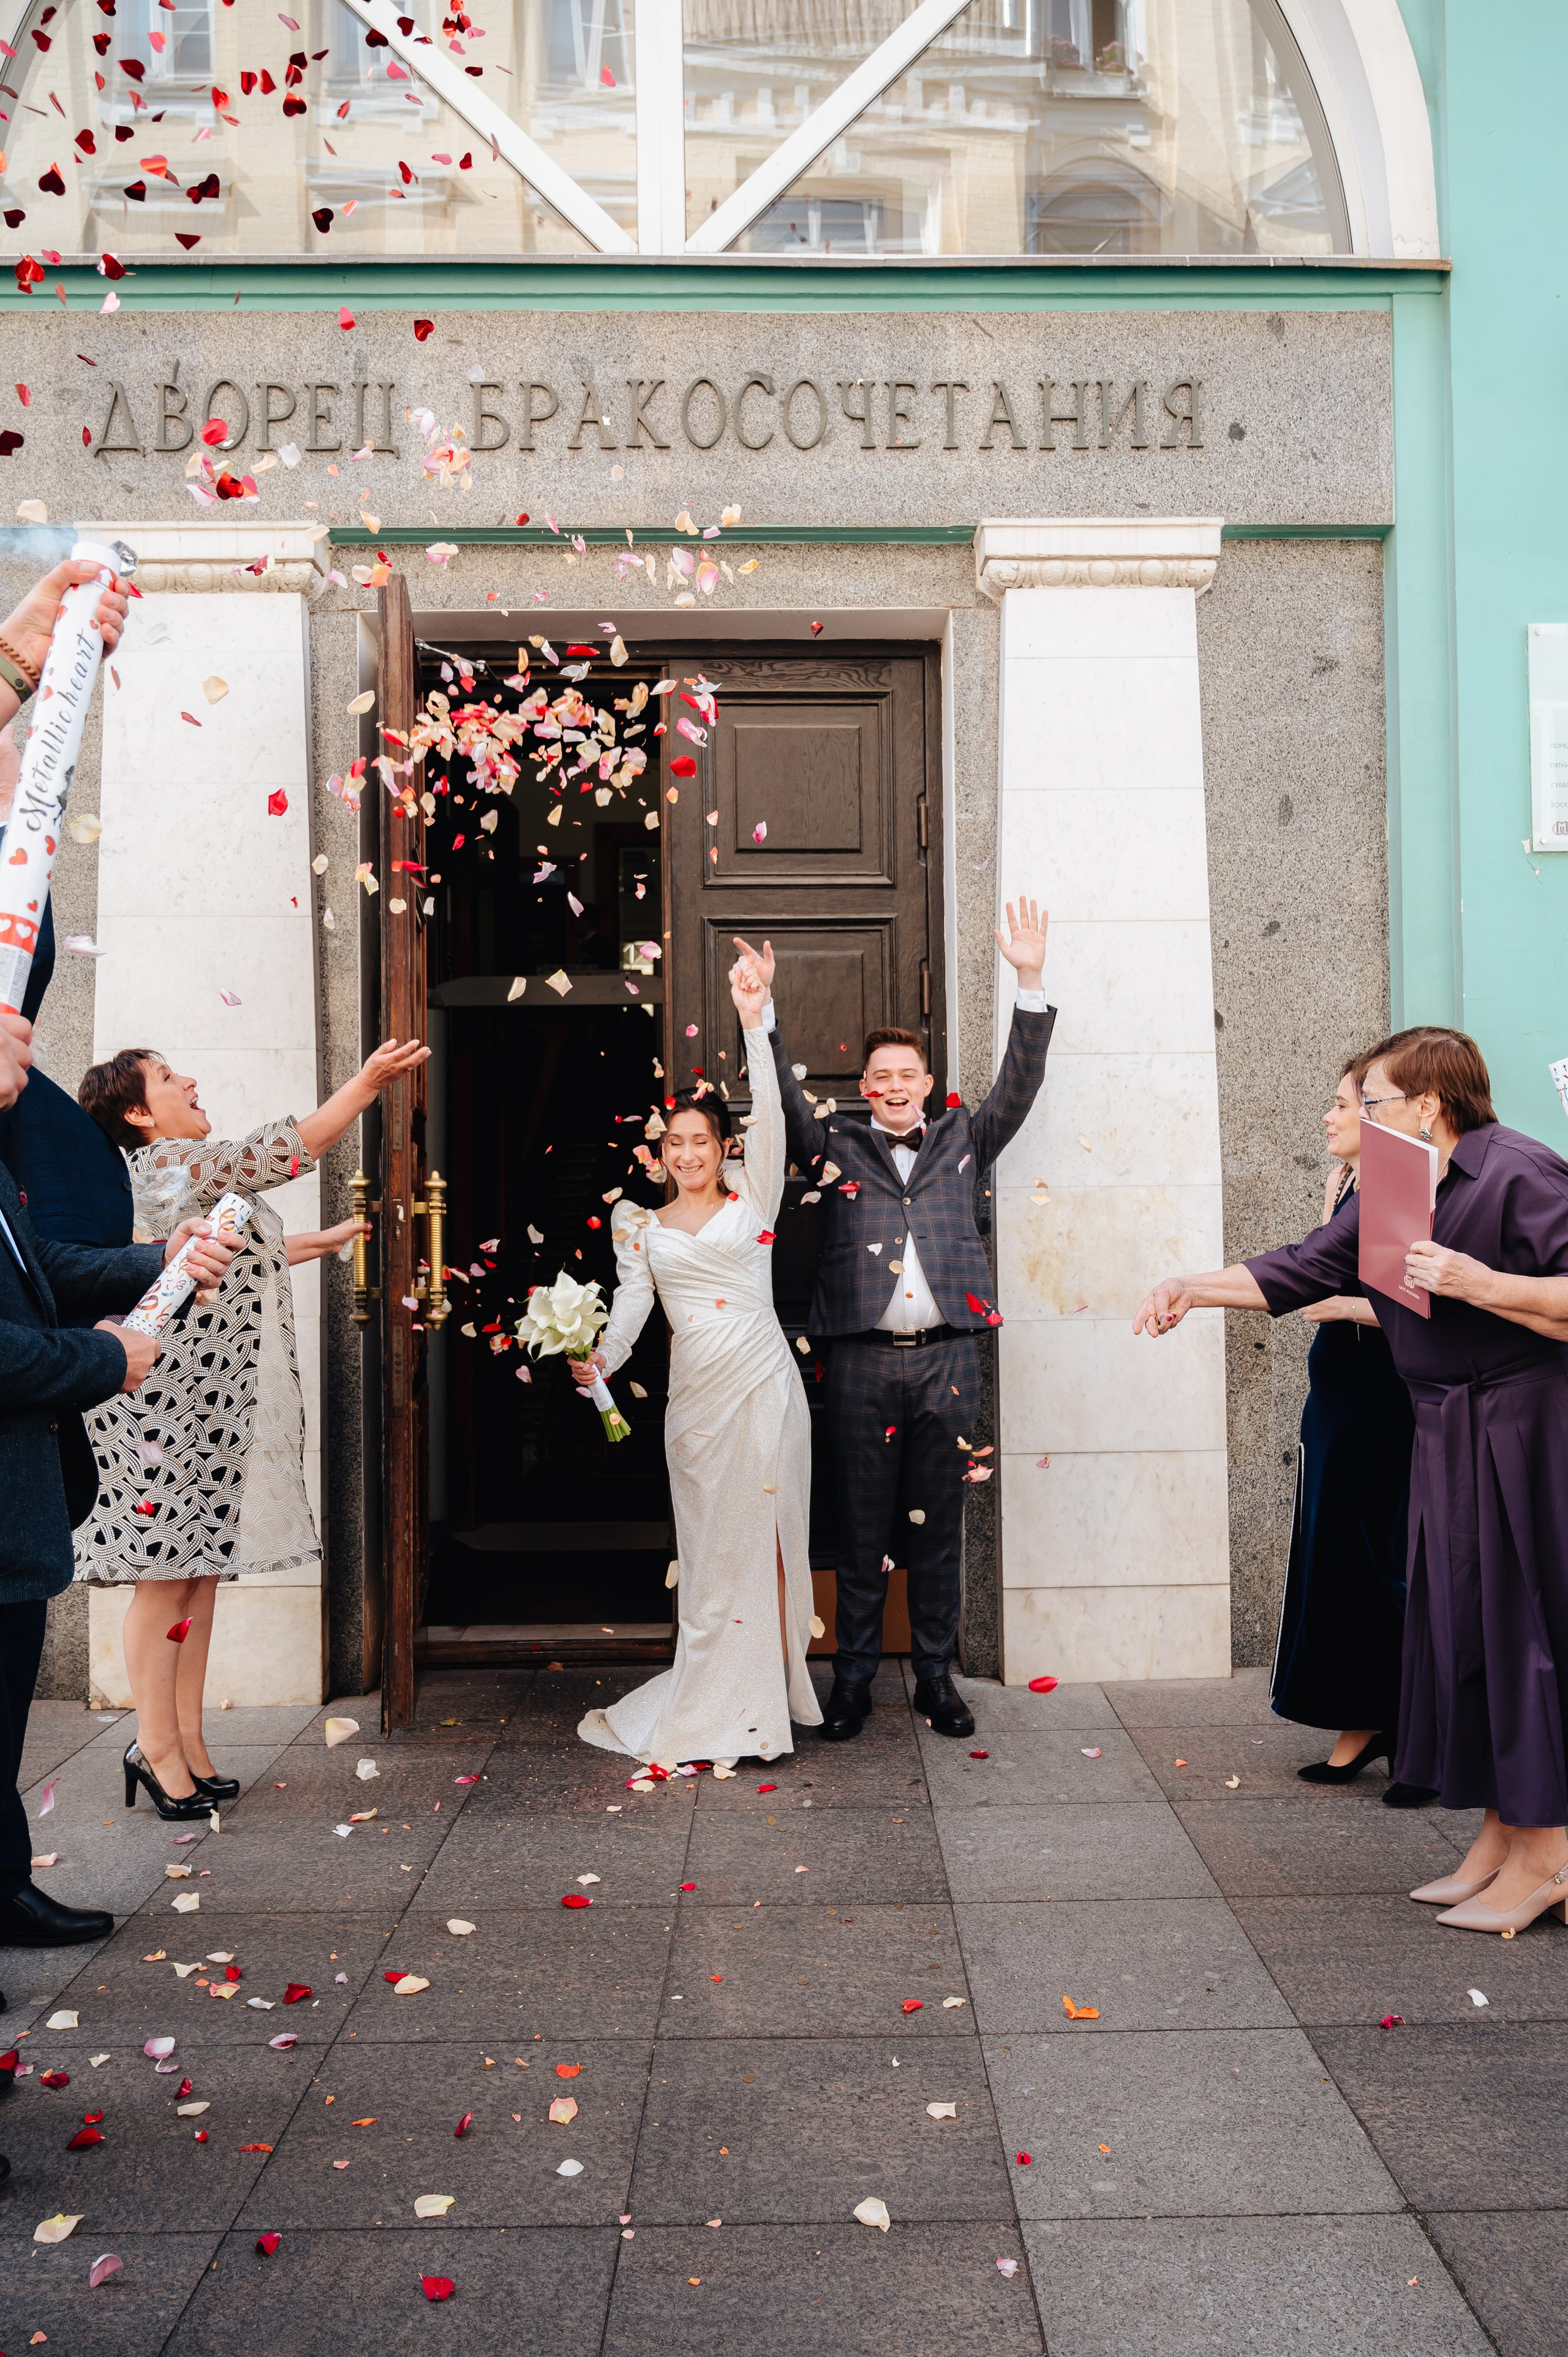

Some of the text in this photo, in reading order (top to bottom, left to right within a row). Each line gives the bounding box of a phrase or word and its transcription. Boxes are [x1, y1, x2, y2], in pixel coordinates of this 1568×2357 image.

[93, 376, 1204, 459] ДВОРЕЦ БРАКОСОЧЕТАНИЯ
[19, 627, 96, 832] Metallic heart
